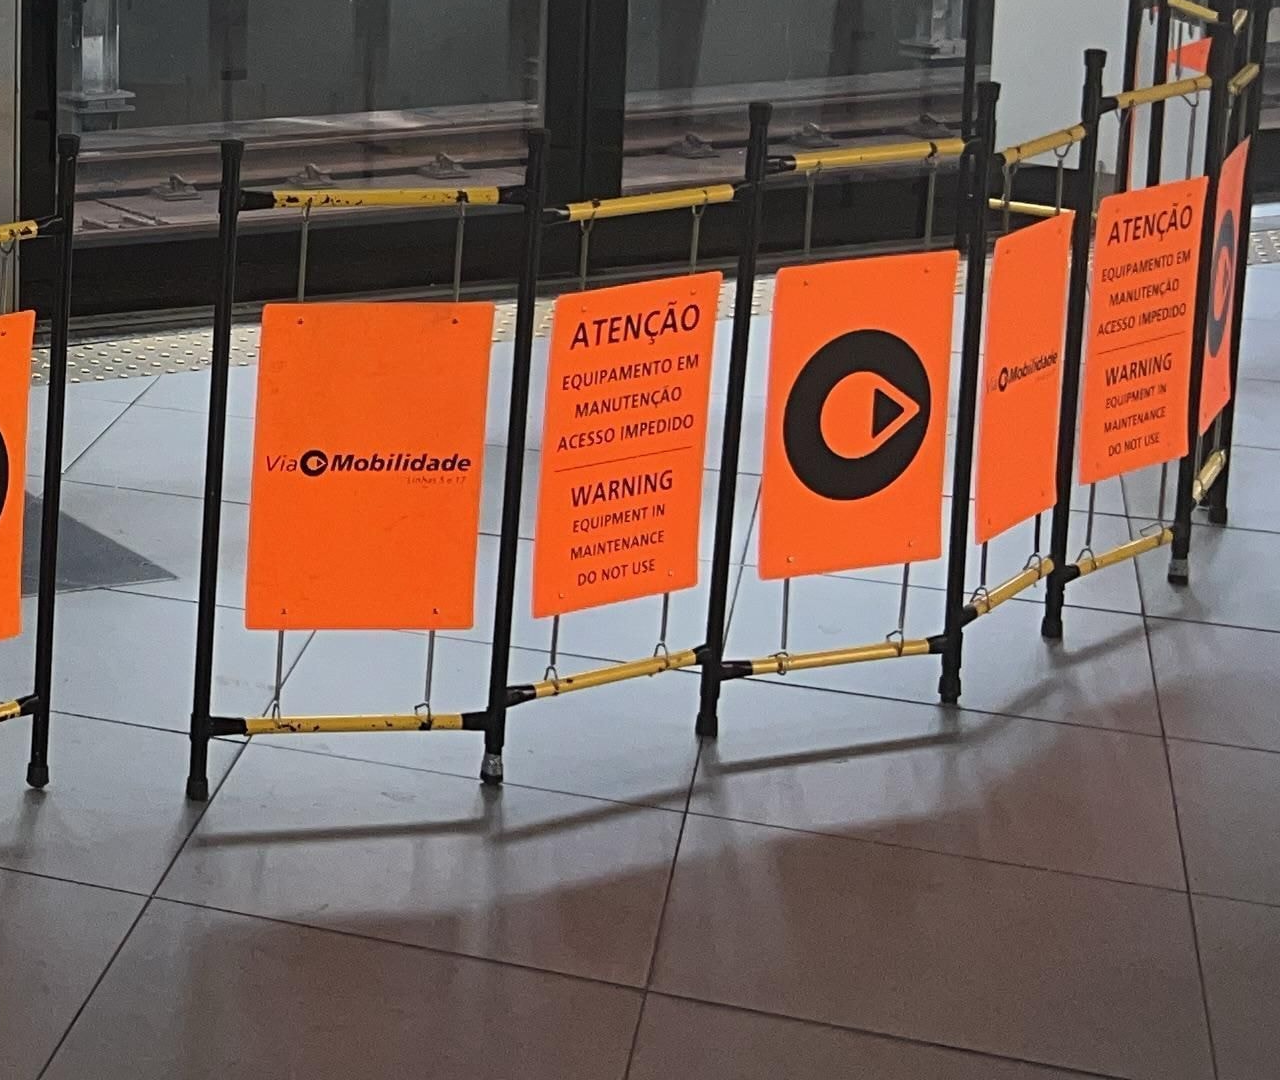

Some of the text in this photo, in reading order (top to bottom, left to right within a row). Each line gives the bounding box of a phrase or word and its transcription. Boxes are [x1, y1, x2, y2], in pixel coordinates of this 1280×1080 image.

[1107, 202, 1193, 246] ATENÇÃO
[1102, 249, 1191, 283] EQUIPAMENTO EM
[1109, 277, 1179, 307] MANUTENÇÃO
[570, 300, 700, 351] ATENÇÃO
[1097, 302, 1186, 337] ACESSO IMPEDIDO
[562, 353, 699, 391] EQUIPAMENTO EM
[1105, 352, 1173, 387] WARNING
[575, 385, 682, 419] MANUTENÇÃO
[557, 414, 694, 453] ACESSO IMPEDIDO
[266, 453, 472, 472] Via Mobilidade
[571, 469, 673, 508] WARNING
